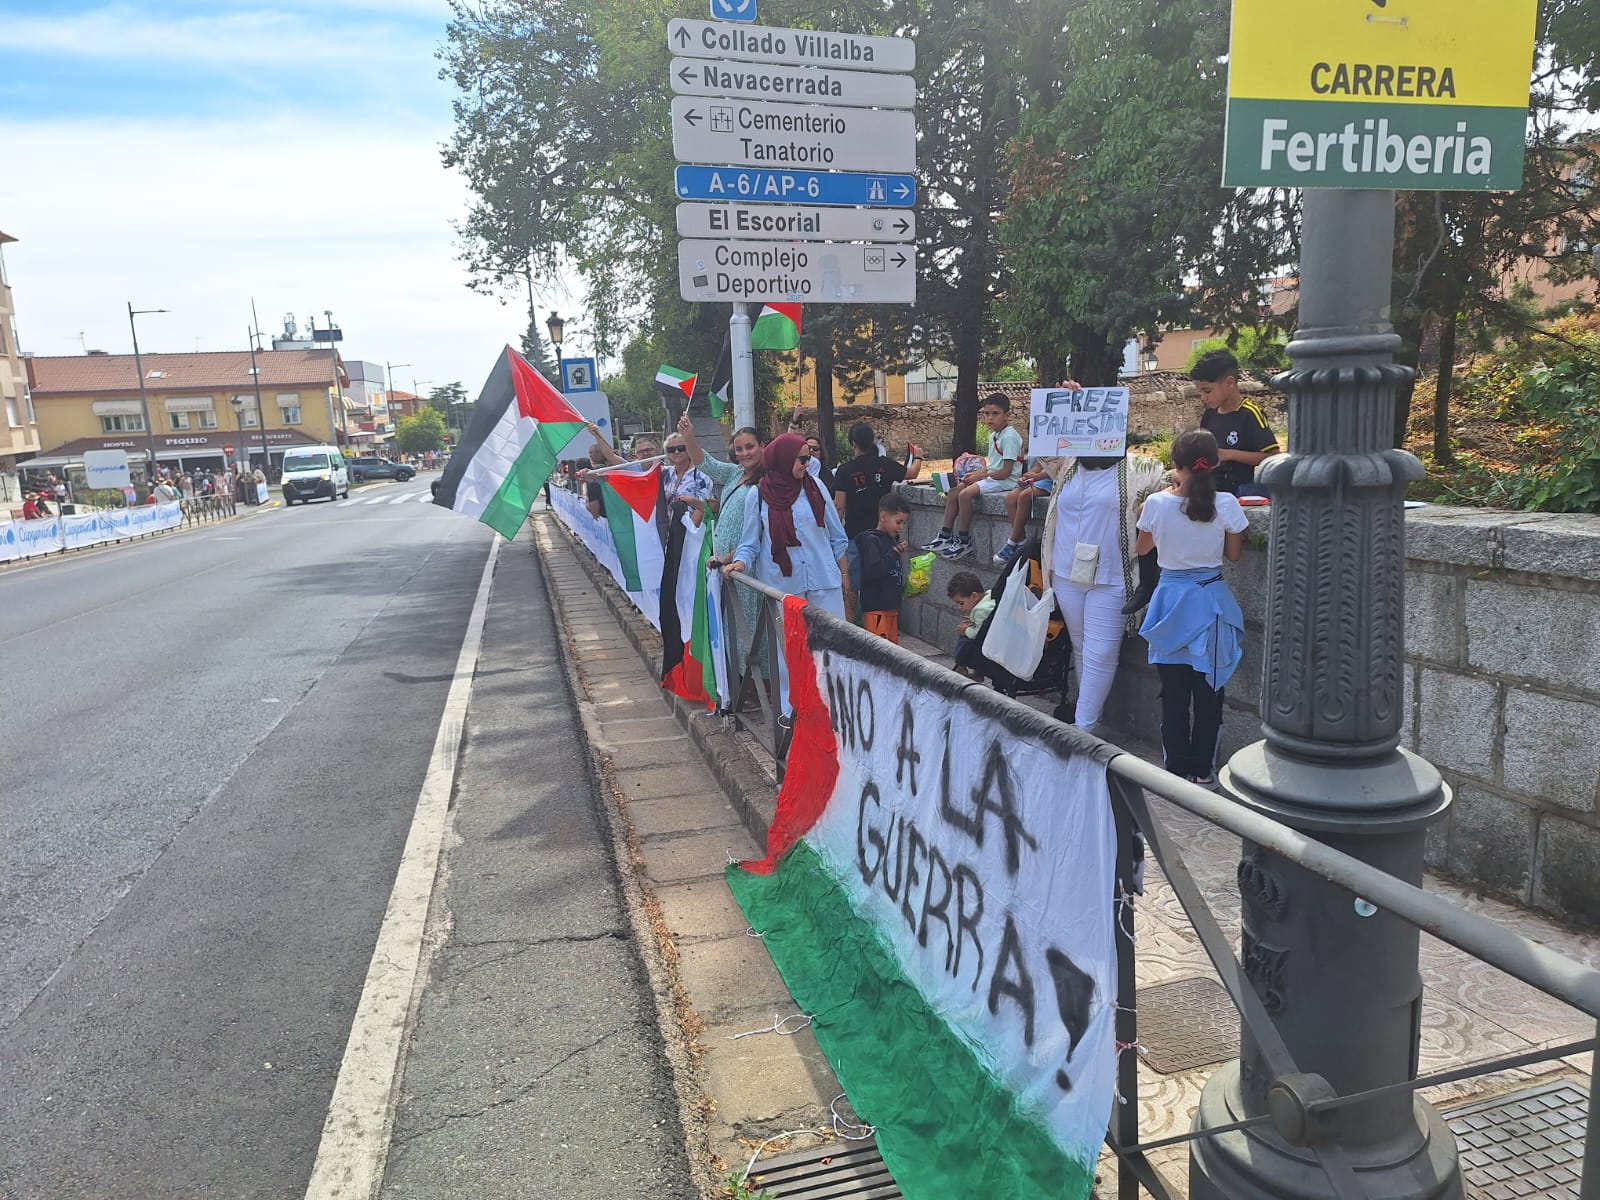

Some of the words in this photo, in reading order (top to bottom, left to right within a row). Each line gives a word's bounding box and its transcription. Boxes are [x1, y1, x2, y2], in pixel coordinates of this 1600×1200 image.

[701, 27, 786, 55] Collado
[795, 34, 875, 62] Villalba
[703, 65, 842, 97] Navacerrada
[1311, 62, 1456, 98] CARRERA
[738, 107, 846, 134] Cementerio
[740, 138, 834, 163] Tanatorio
[1260, 118, 1492, 175] Fertiberia
[708, 172, 820, 198] A-6/AP-6
[709, 209, 729, 230] El
[737, 210, 820, 233] Escorial
[715, 245, 808, 272] Complejo
[716, 272, 812, 298] Deportivo
[1045, 390, 1123, 413] FREE
[165, 437, 208, 445] PIQUIO
[896, 699, 921, 796] A
[940, 718, 1038, 876] LA
